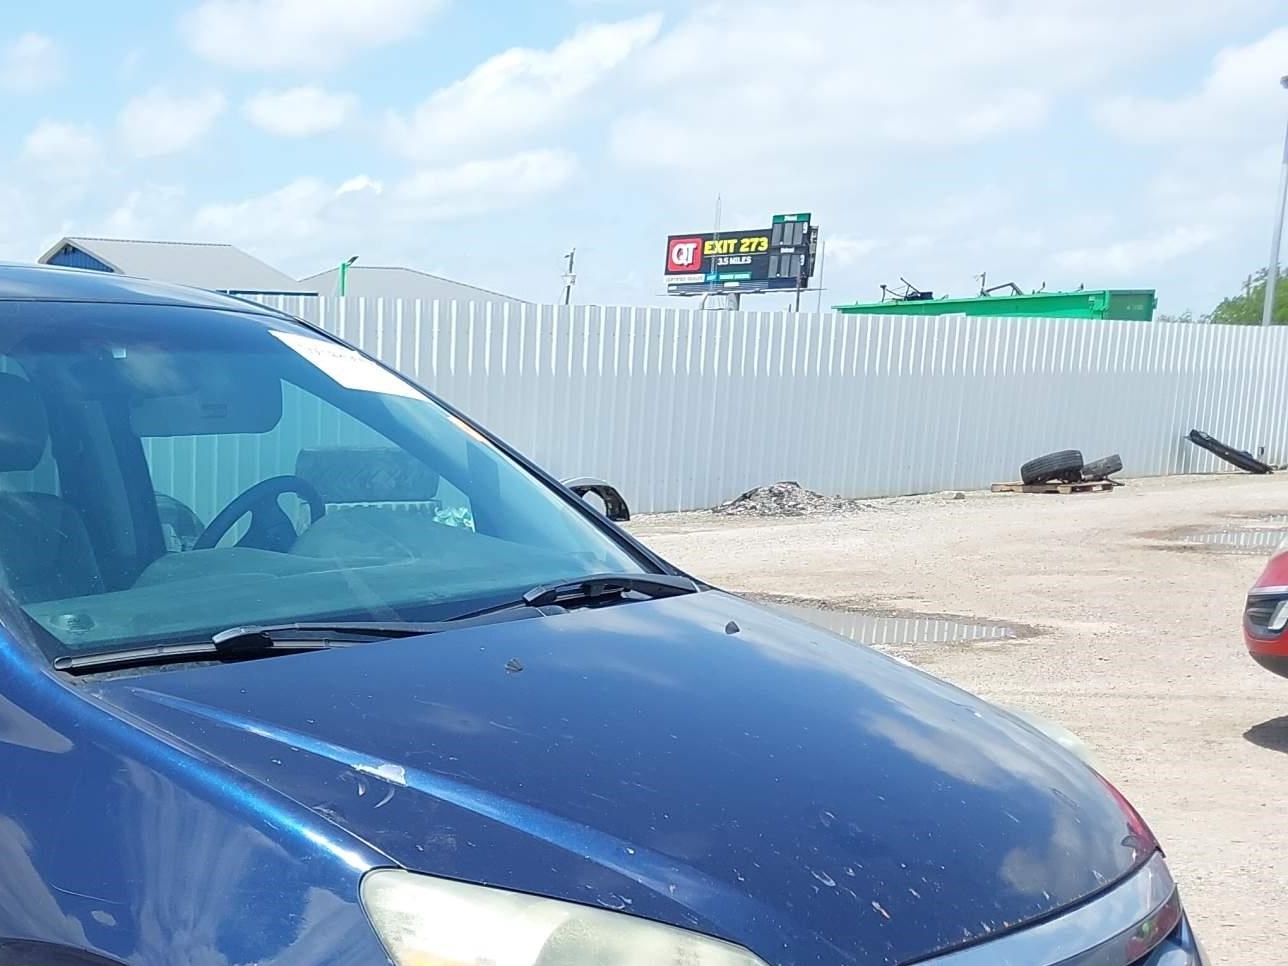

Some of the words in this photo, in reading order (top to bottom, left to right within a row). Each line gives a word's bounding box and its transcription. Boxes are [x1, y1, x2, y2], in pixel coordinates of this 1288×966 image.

[671, 243, 697, 267] QT
[704, 239, 737, 255] EXIT
[739, 236, 769, 252] 273
[729, 255, 752, 265] MILES
